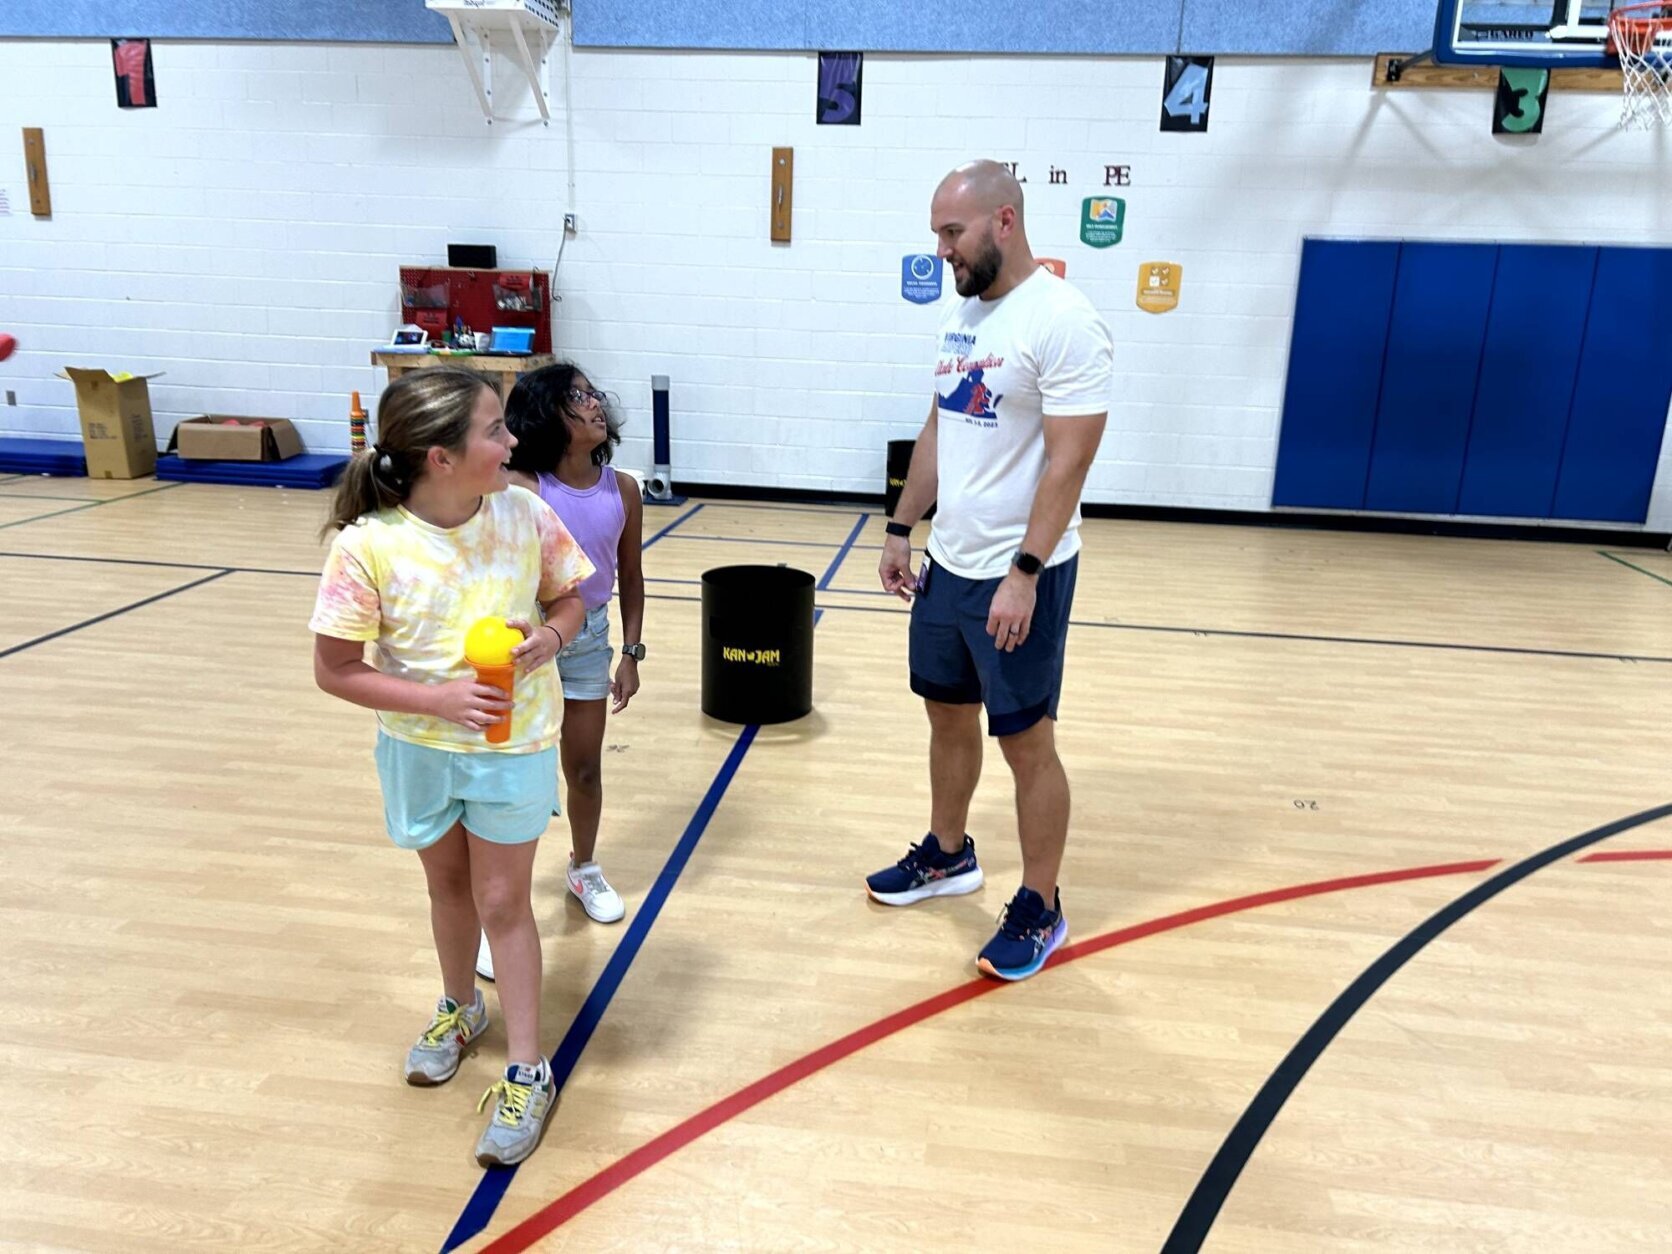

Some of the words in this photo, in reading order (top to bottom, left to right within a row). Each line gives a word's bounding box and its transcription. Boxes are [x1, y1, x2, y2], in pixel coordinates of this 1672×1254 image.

[115, 41, 147, 105] 1
[819, 56, 859, 123] 5
[1163, 63, 1209, 125] 4
[1501, 67, 1548, 132] 3
[1048, 164, 1069, 185] in
[1103, 164, 1132, 187] PE
[723, 646, 746, 663] KAN
[755, 649, 781, 665] JAM
